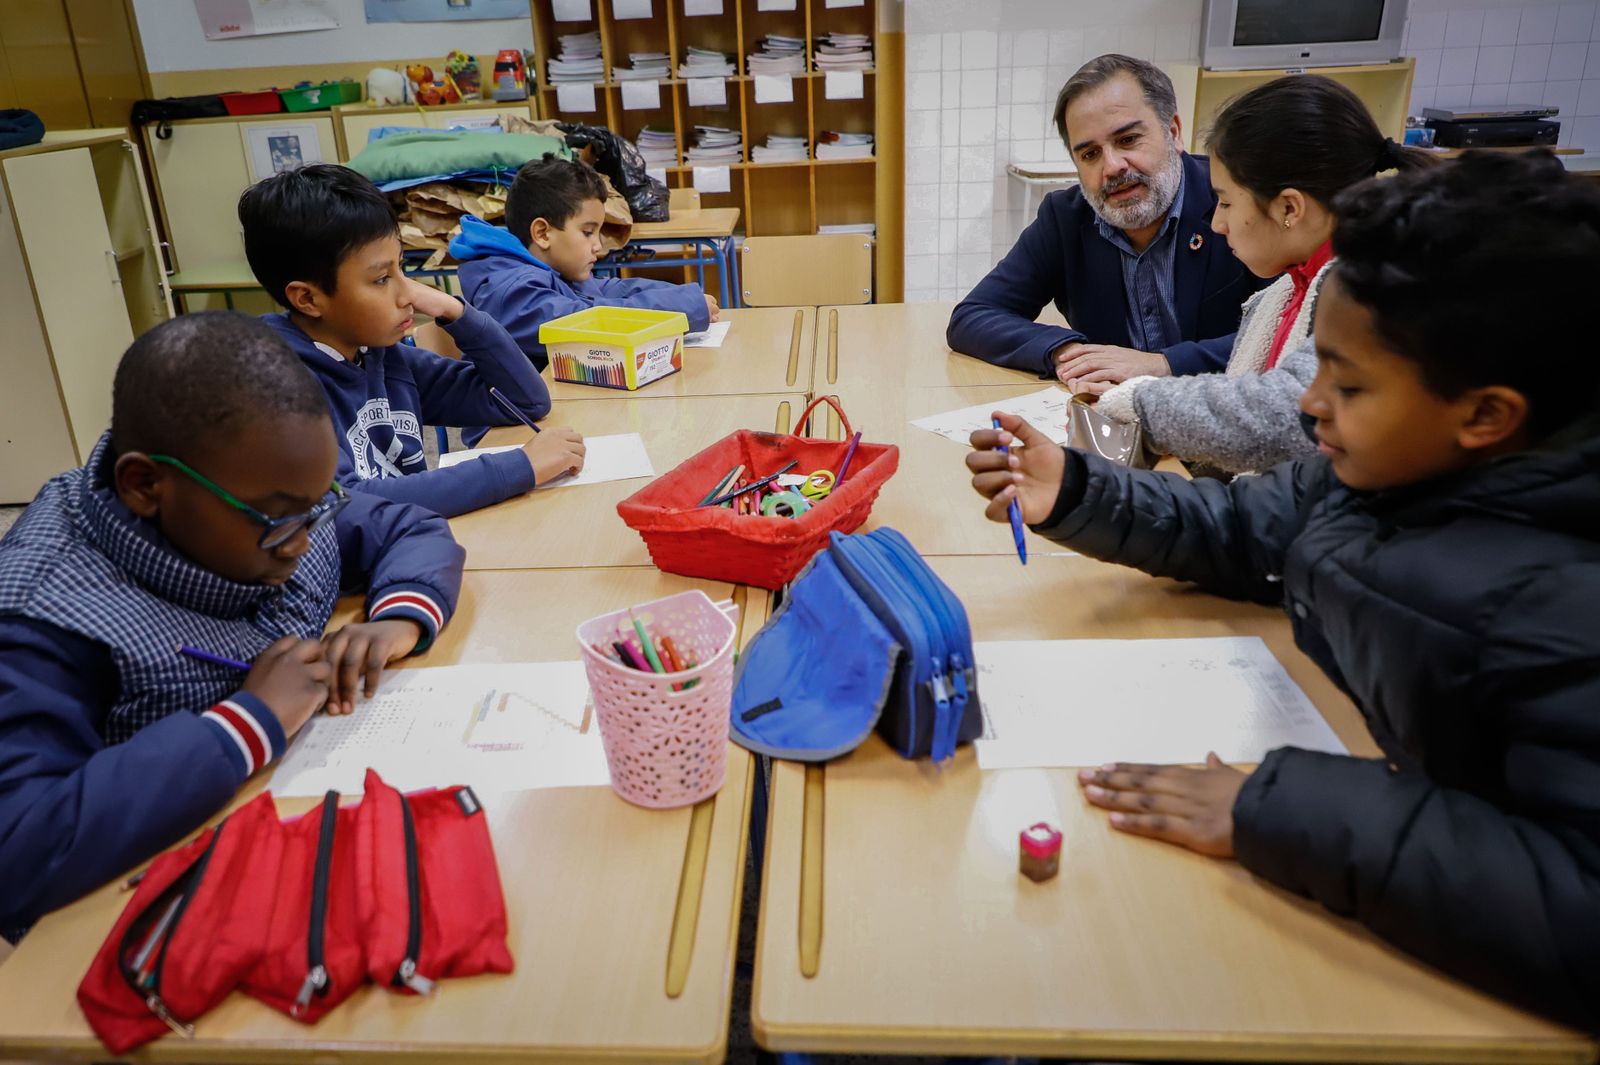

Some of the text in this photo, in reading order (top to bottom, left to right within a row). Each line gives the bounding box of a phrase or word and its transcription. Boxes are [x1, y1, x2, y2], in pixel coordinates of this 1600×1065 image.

[588, 349, 611, 357] GIOTTO
[647, 345, 669, 359] GIOTTO
[360, 407, 389, 424] SPORT
